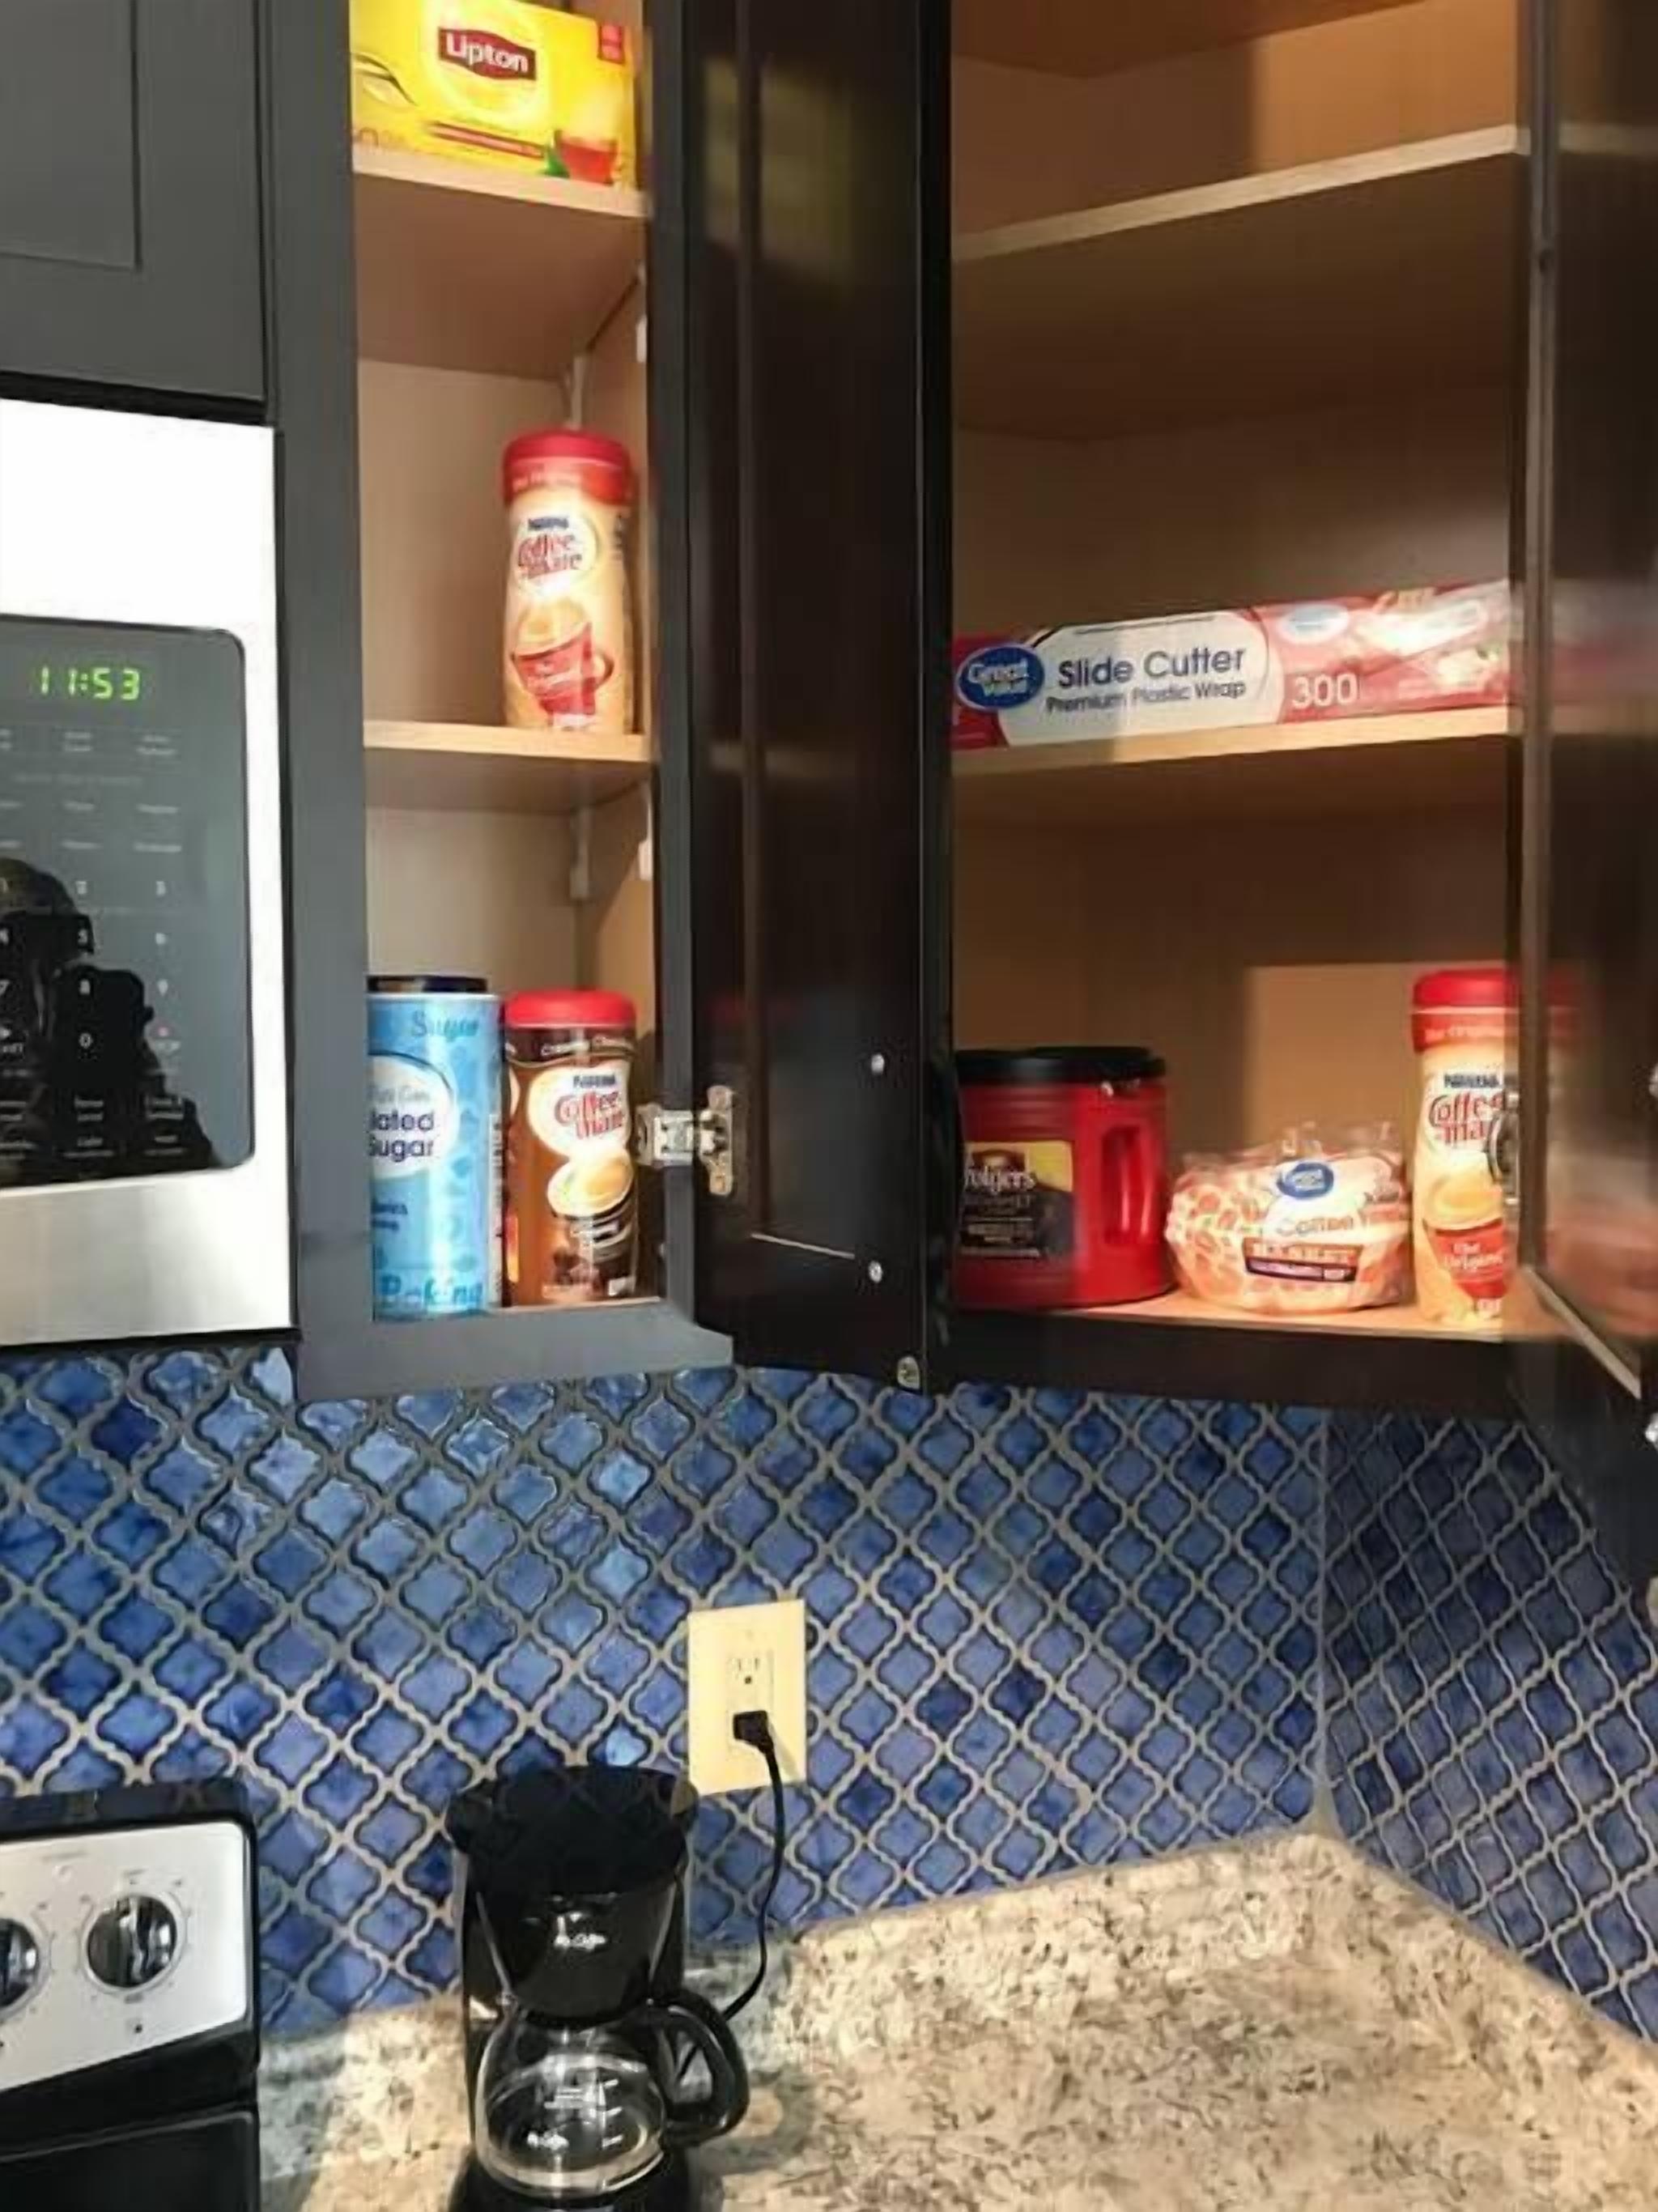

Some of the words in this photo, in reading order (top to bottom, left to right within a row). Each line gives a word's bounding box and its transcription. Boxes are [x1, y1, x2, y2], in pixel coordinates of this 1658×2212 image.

[445, 32, 529, 74] Lipton
[40, 666, 141, 701] 11:53
[1058, 656, 1134, 689] Slide
[1142, 645, 1247, 678] Cutter
[1047, 692, 1128, 714] Premium
[1193, 682, 1248, 700] Wrap
[1292, 672, 1358, 710] 300
